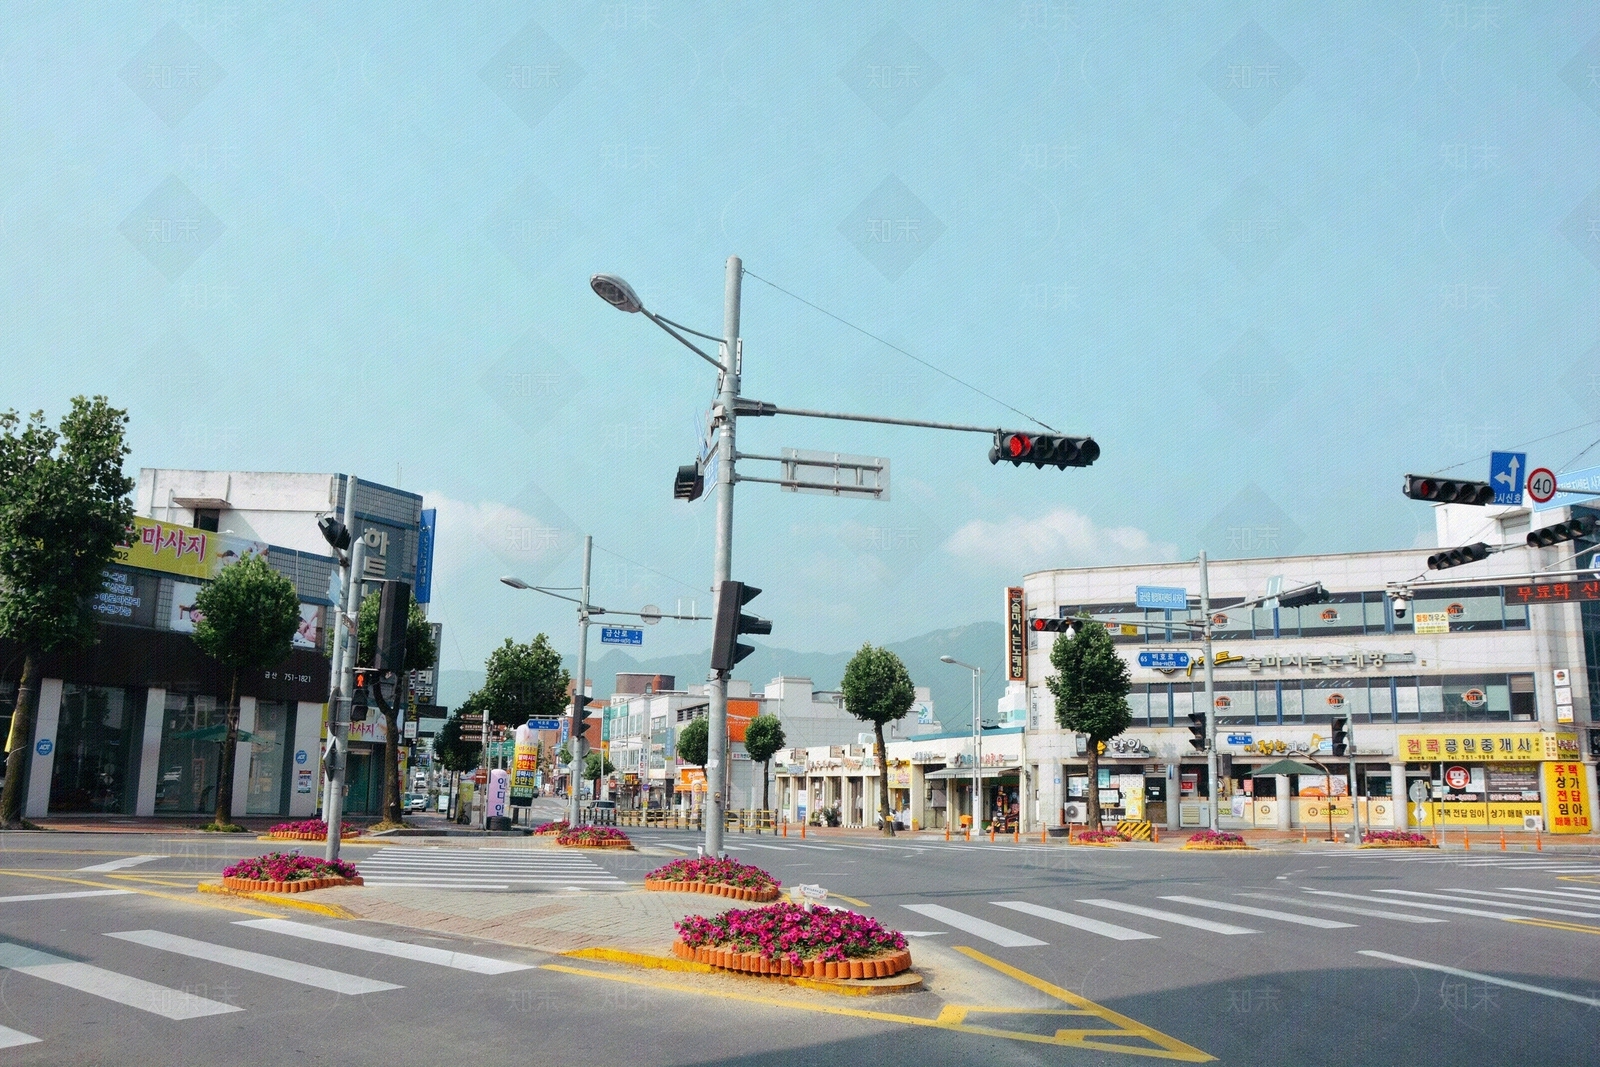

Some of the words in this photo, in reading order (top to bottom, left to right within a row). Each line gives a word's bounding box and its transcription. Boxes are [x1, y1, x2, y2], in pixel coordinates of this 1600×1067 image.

[1532, 479, 1552, 495] 40
[142, 524, 207, 563] 마사지
[1517, 583, 1571, 602] 무료화
[606, 629, 628, 638] 금산로
[1011, 602, 1022, 678] 술마시는노래방
[1246, 650, 1388, 673] 술마시는노래방
[284, 674, 311, 683] 751-1821
[1407, 737, 1532, 754] 건국공인중개사
[1555, 777, 1579, 790] 상가
[1453, 809, 1468, 818] 전답
[1469, 809, 1485, 818] 임야
[1490, 809, 1506, 819] 상가
[1558, 803, 1582, 815] 임야
